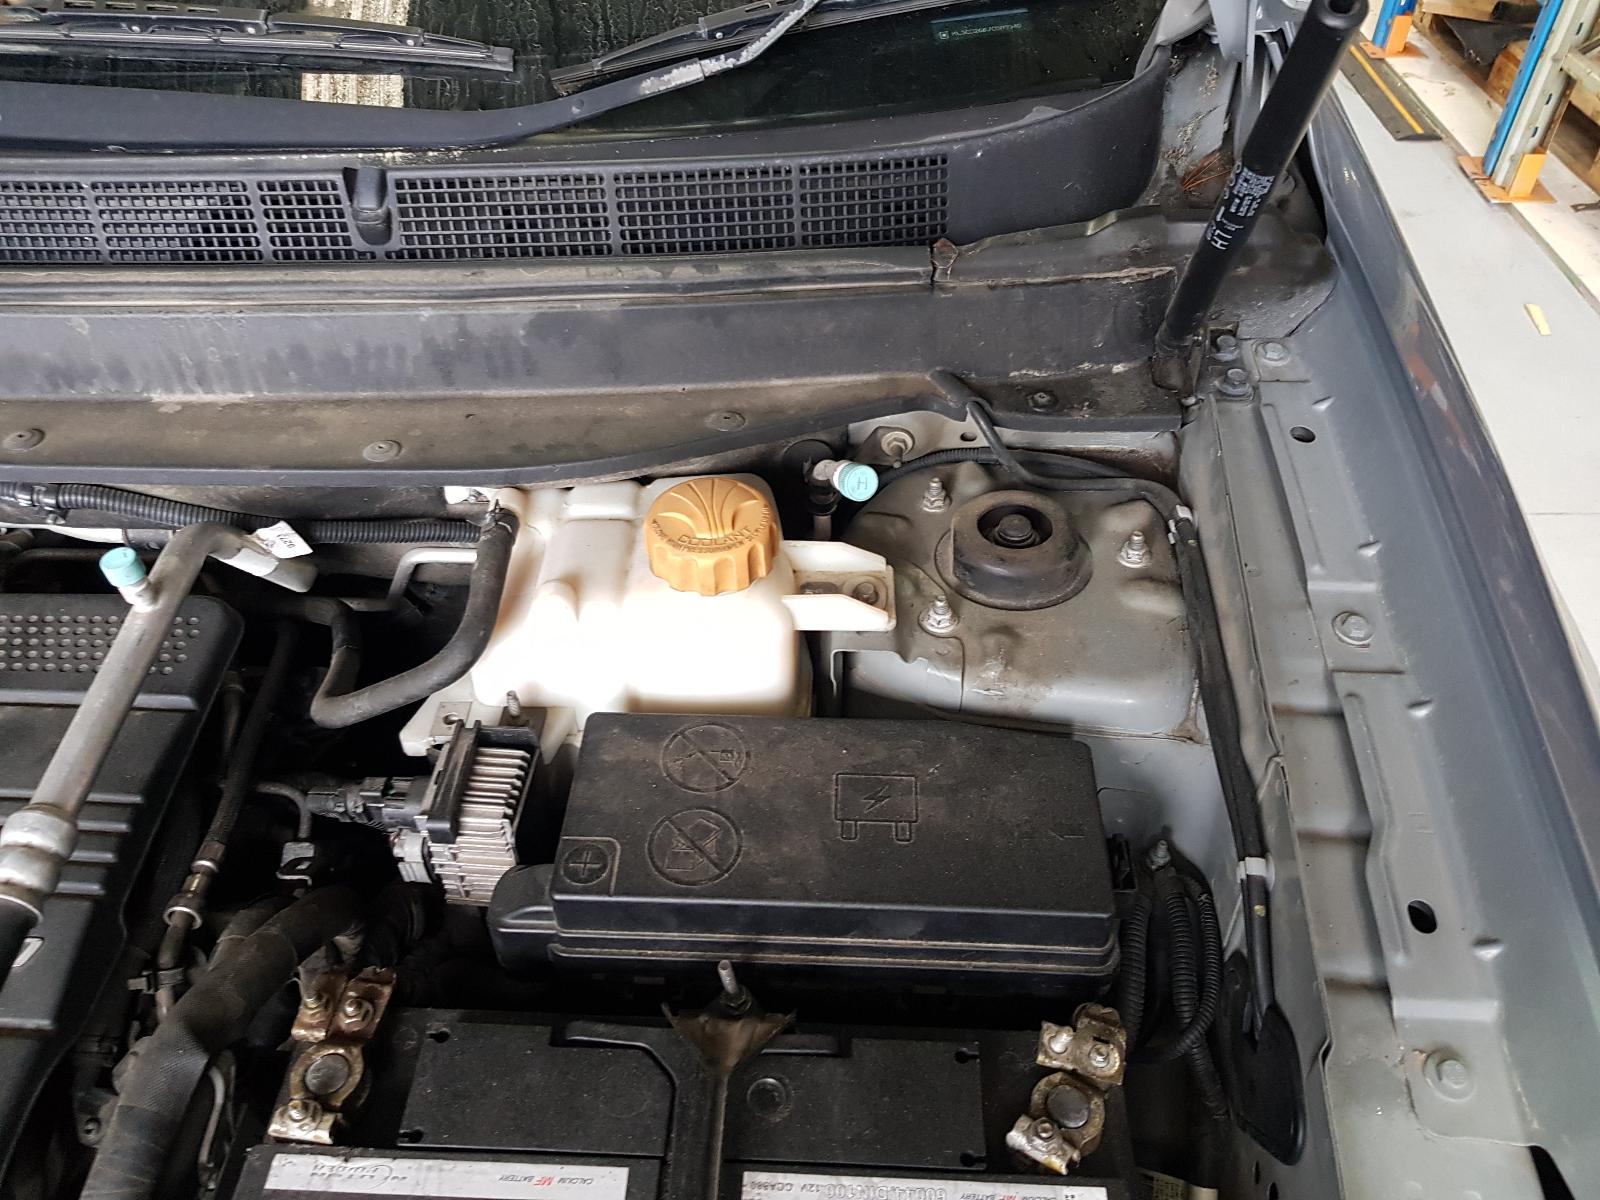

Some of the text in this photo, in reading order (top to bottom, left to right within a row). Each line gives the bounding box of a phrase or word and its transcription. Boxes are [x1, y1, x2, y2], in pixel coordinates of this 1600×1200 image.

[677, 525, 751, 547] COOLANT
[498, 1174, 594, 1186] CALCIUM MF BATTERY
